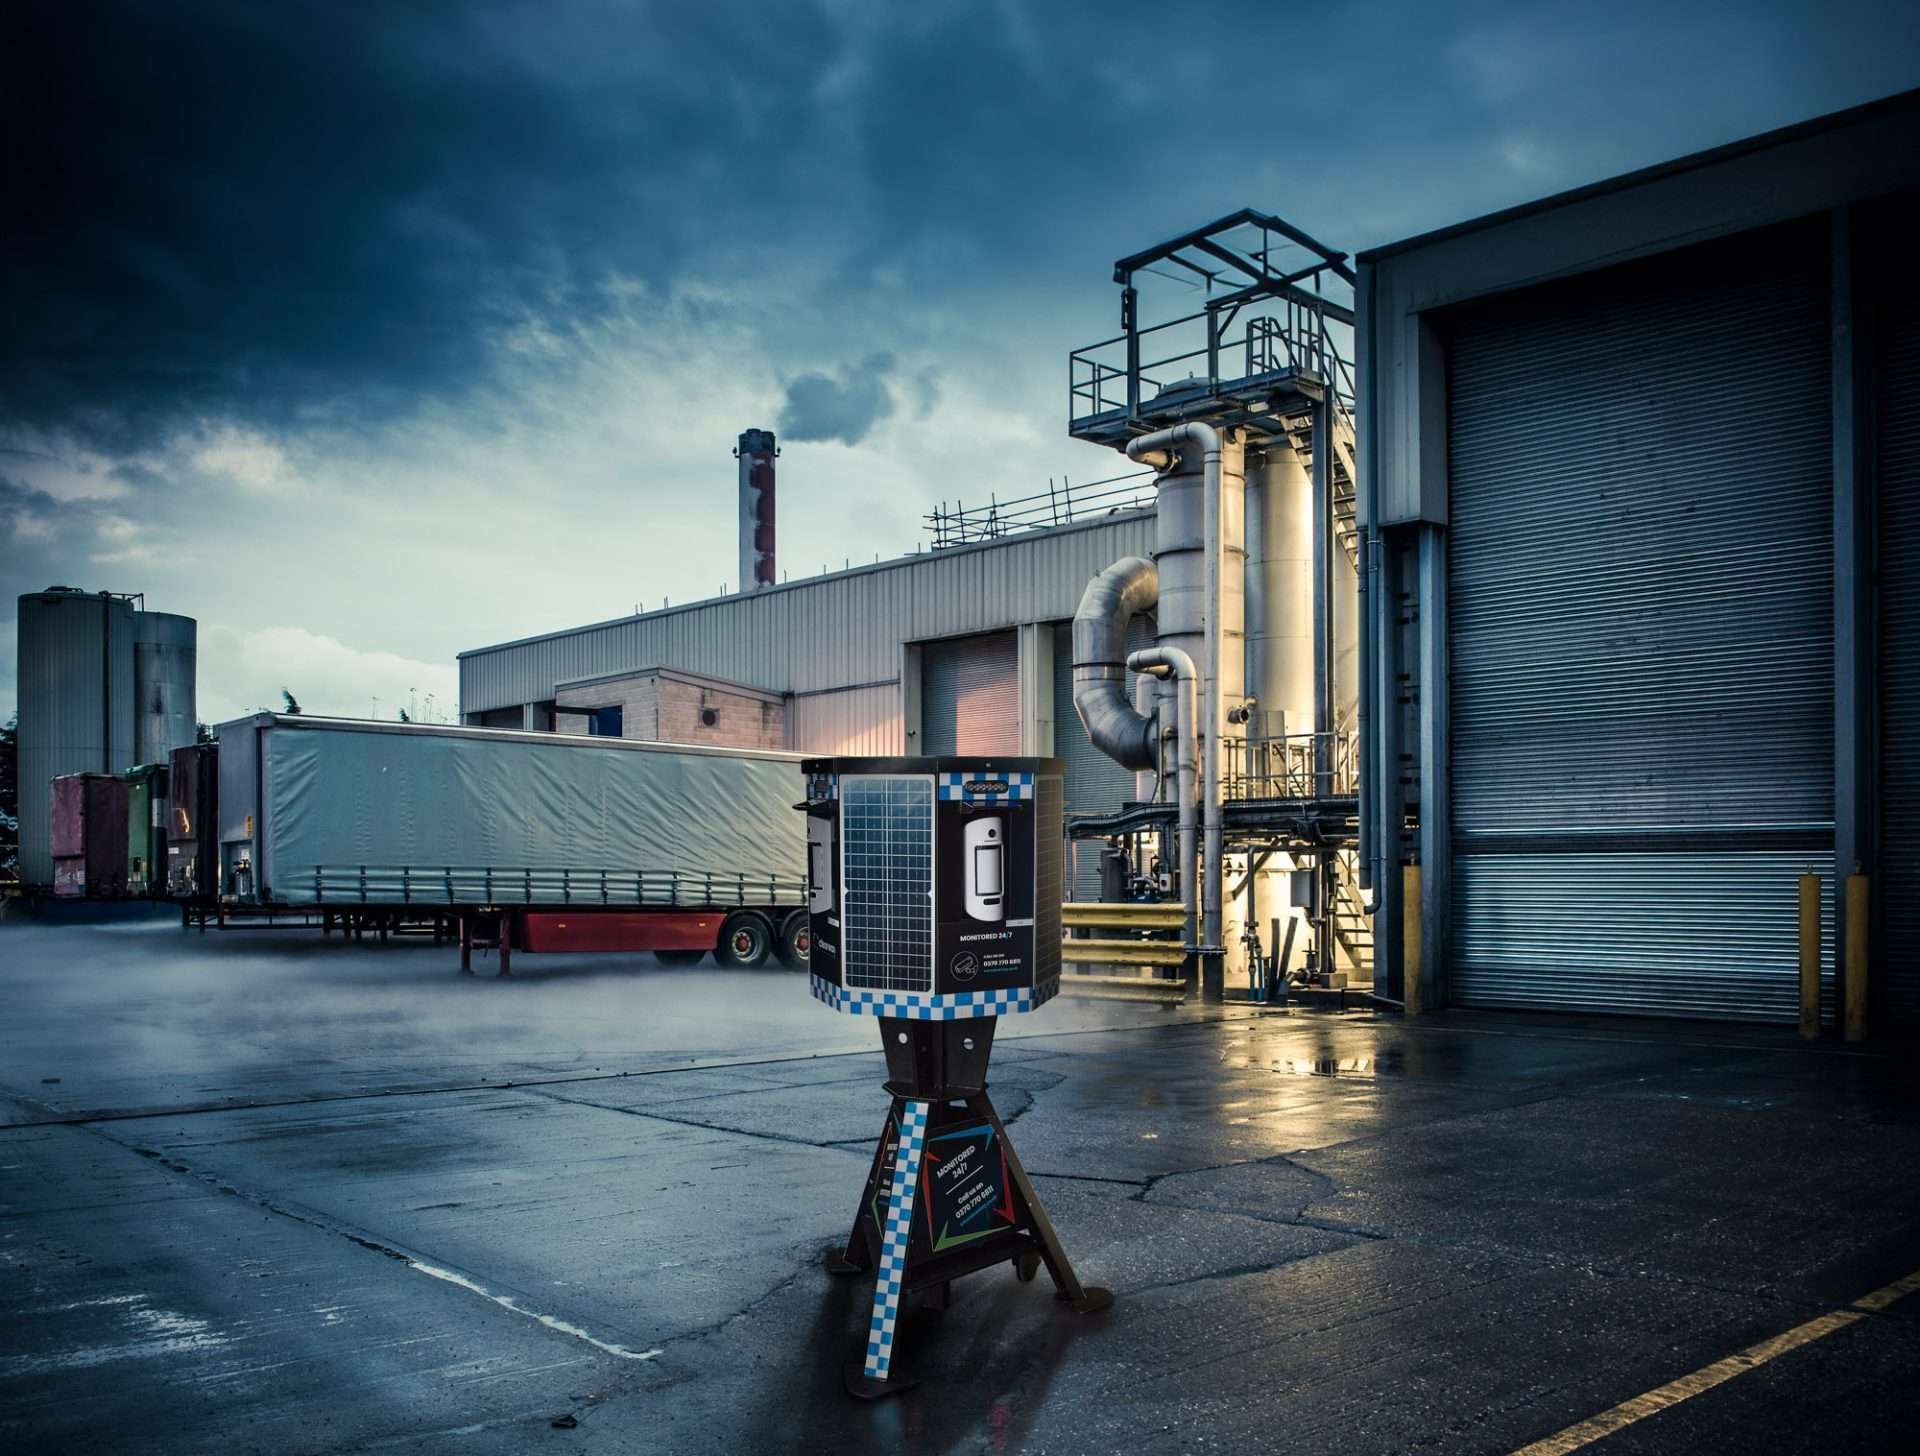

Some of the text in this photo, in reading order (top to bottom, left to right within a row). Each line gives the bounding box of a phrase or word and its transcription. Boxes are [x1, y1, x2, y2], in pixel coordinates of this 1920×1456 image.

[960, 933, 997, 941] MONITORED
[936, 1146, 976, 1178] MONITORED
[952, 1162, 968, 1178] 24/7
[958, 1193, 970, 1204] Call
[976, 1182, 984, 1190] on
[956, 1204, 971, 1218] 0370
[970, 1195, 982, 1208] 770
